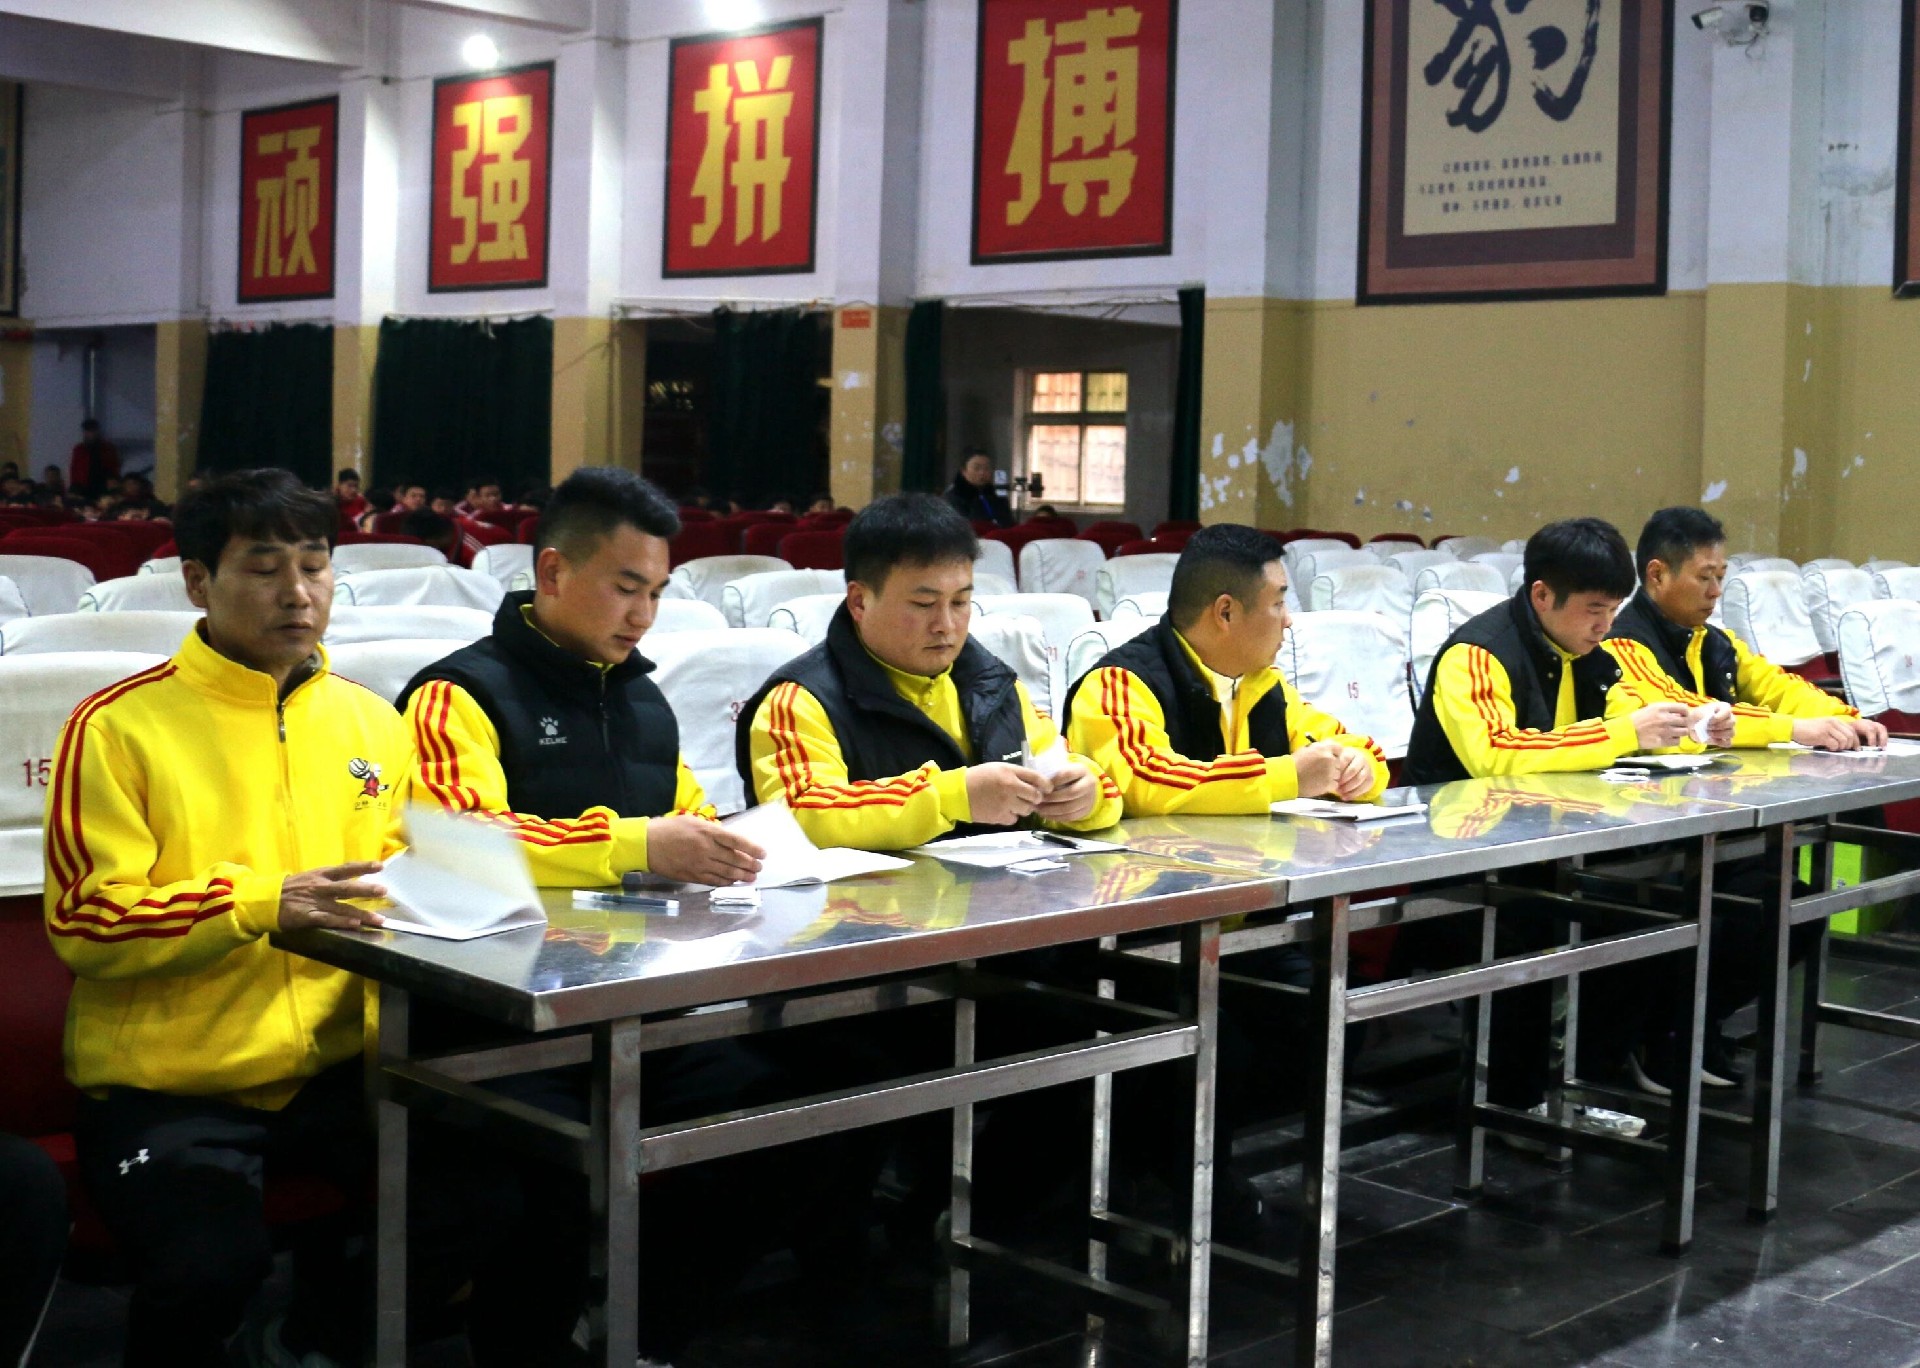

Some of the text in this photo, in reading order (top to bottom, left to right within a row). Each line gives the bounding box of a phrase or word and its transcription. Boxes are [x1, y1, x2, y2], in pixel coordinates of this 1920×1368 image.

[450, 95, 532, 264] 强
[691, 55, 793, 247] 拼
[1006, 7, 1141, 226] 搏
[254, 127, 320, 278] 顽
[539, 736, 568, 746] KELME
[1347, 681, 1360, 699] 15
[22, 758, 52, 788] 15
